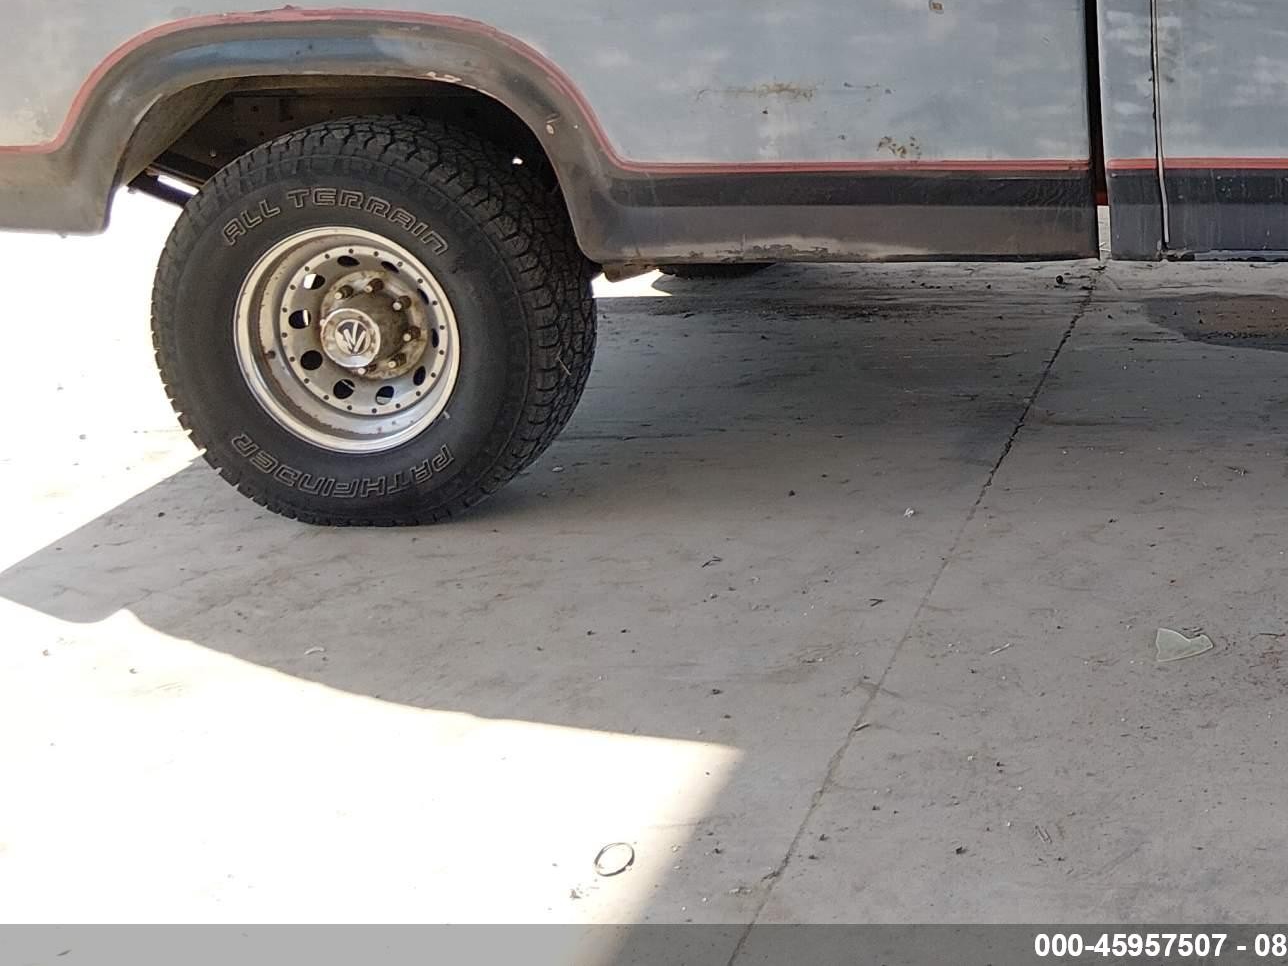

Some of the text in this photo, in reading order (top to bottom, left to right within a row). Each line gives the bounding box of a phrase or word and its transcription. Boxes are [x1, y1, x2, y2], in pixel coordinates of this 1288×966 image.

[222, 187, 449, 256] ALL TERRAIN
[231, 433, 455, 498] PATHFINDER
